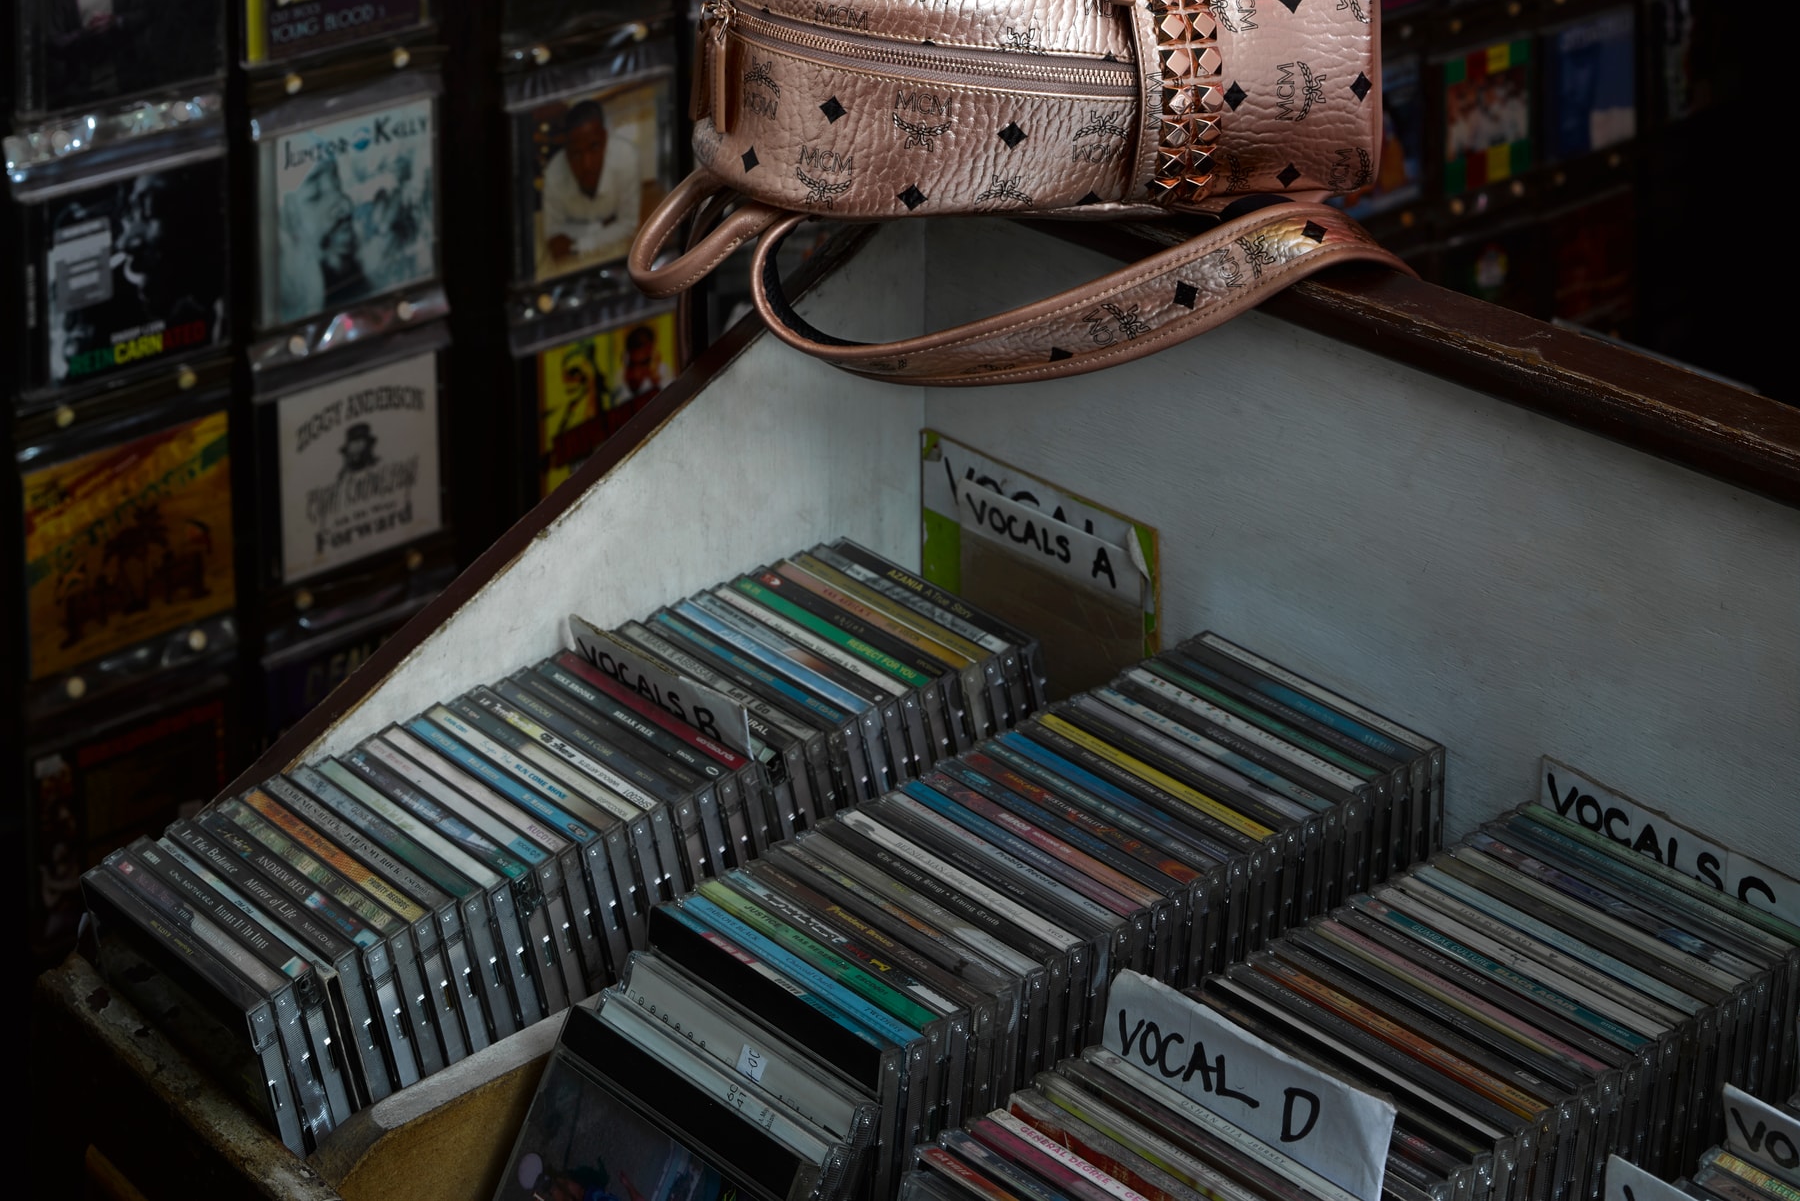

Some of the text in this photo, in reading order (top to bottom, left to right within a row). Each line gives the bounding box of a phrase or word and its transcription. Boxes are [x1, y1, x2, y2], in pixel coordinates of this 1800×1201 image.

[270, 5, 375, 42] YOUNG BLOOD
[814, 2, 869, 30] MCM
[894, 89, 952, 117] MCM
[1275, 61, 1295, 121] MCM
[799, 144, 854, 175] MCM
[67, 320, 207, 377] REINCARNATED
[315, 506, 414, 553] Forward
[965, 492, 1072, 564] VOCALS
[1091, 546, 1117, 589] A
[577, 636, 723, 743] VOCALS B
[1119, 1009, 1322, 1143] VOCAL D
